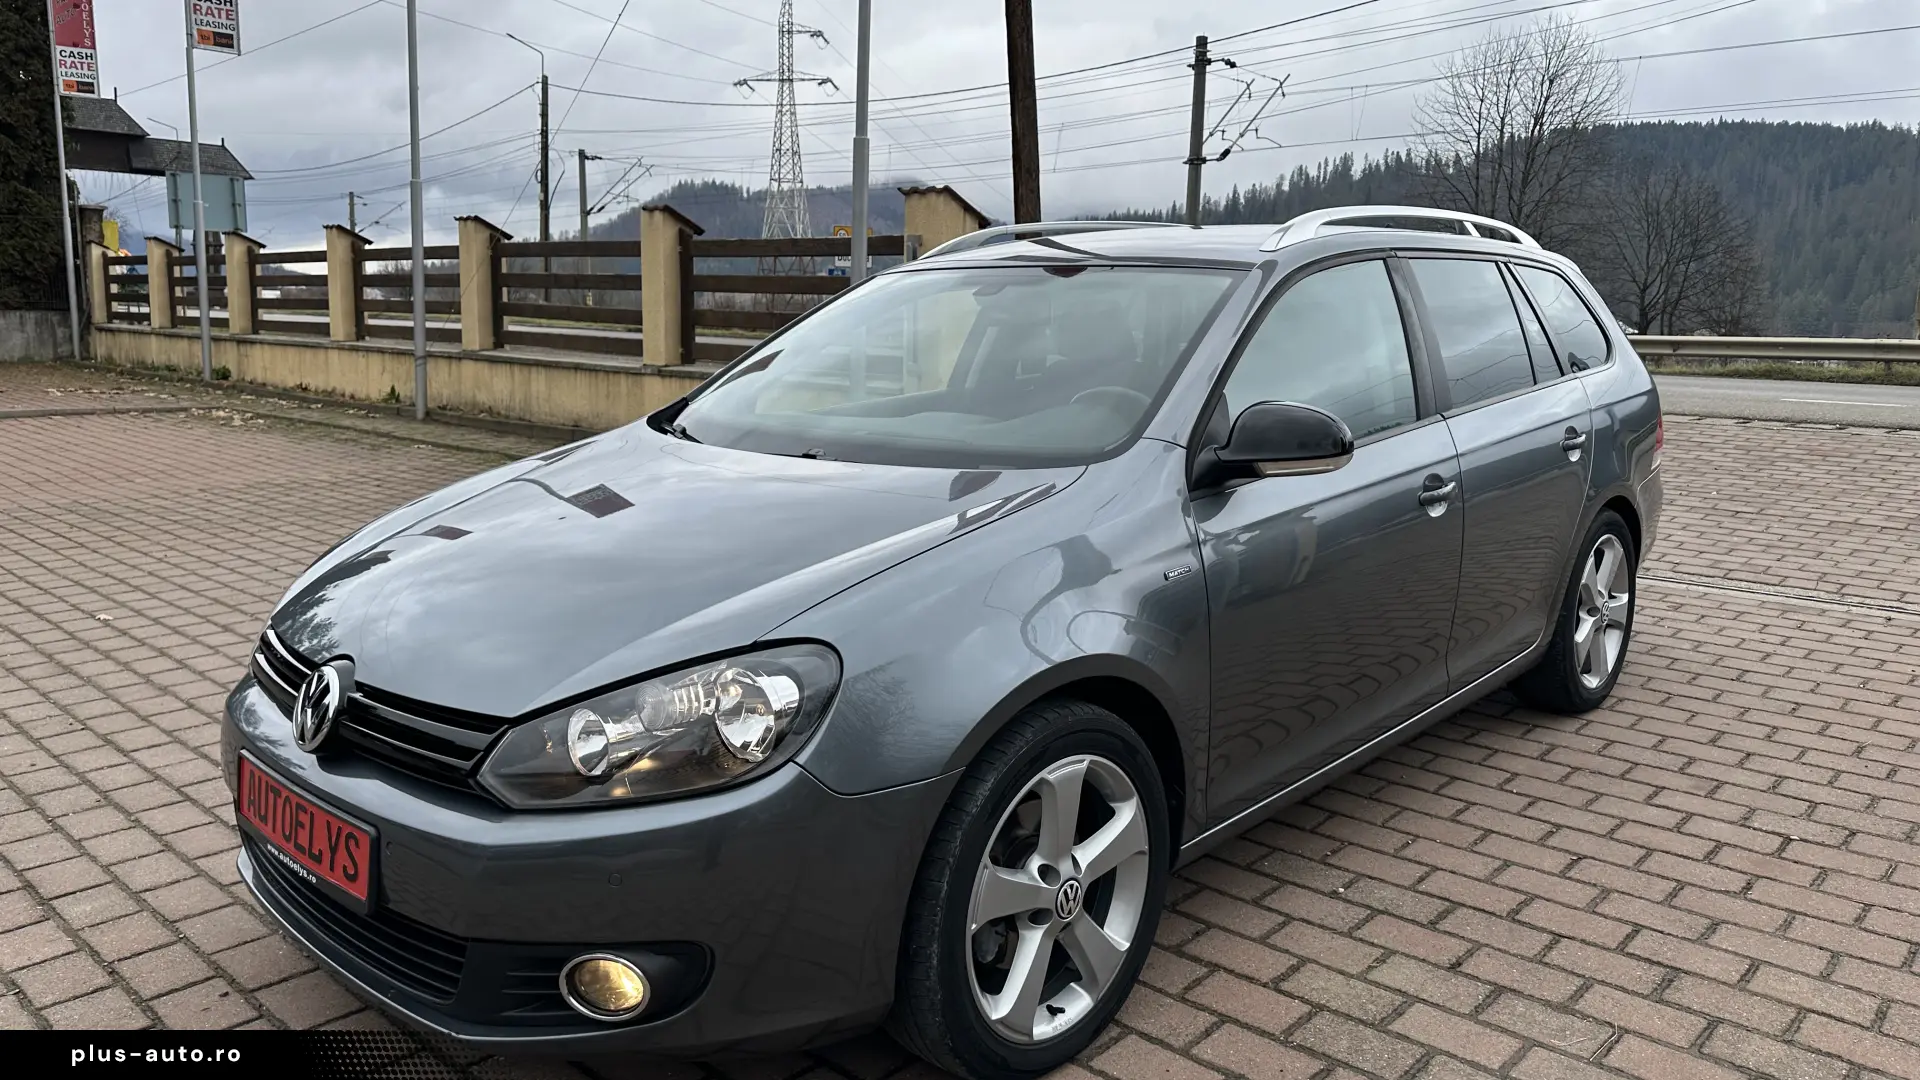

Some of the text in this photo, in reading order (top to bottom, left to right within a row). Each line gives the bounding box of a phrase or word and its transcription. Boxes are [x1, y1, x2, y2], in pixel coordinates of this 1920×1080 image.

[192, 2, 235, 21] RATE
[81, 0, 92, 46] OELYS
[194, 18, 236, 31] LEASING
[59, 49, 94, 61] CASH
[59, 59, 96, 72] RATE
[60, 71, 97, 81] LEASING
[1168, 566, 1190, 577] MATCH
[247, 769, 361, 884] AUTOELYS
[267, 843, 317, 883] www.autoelys.ro
